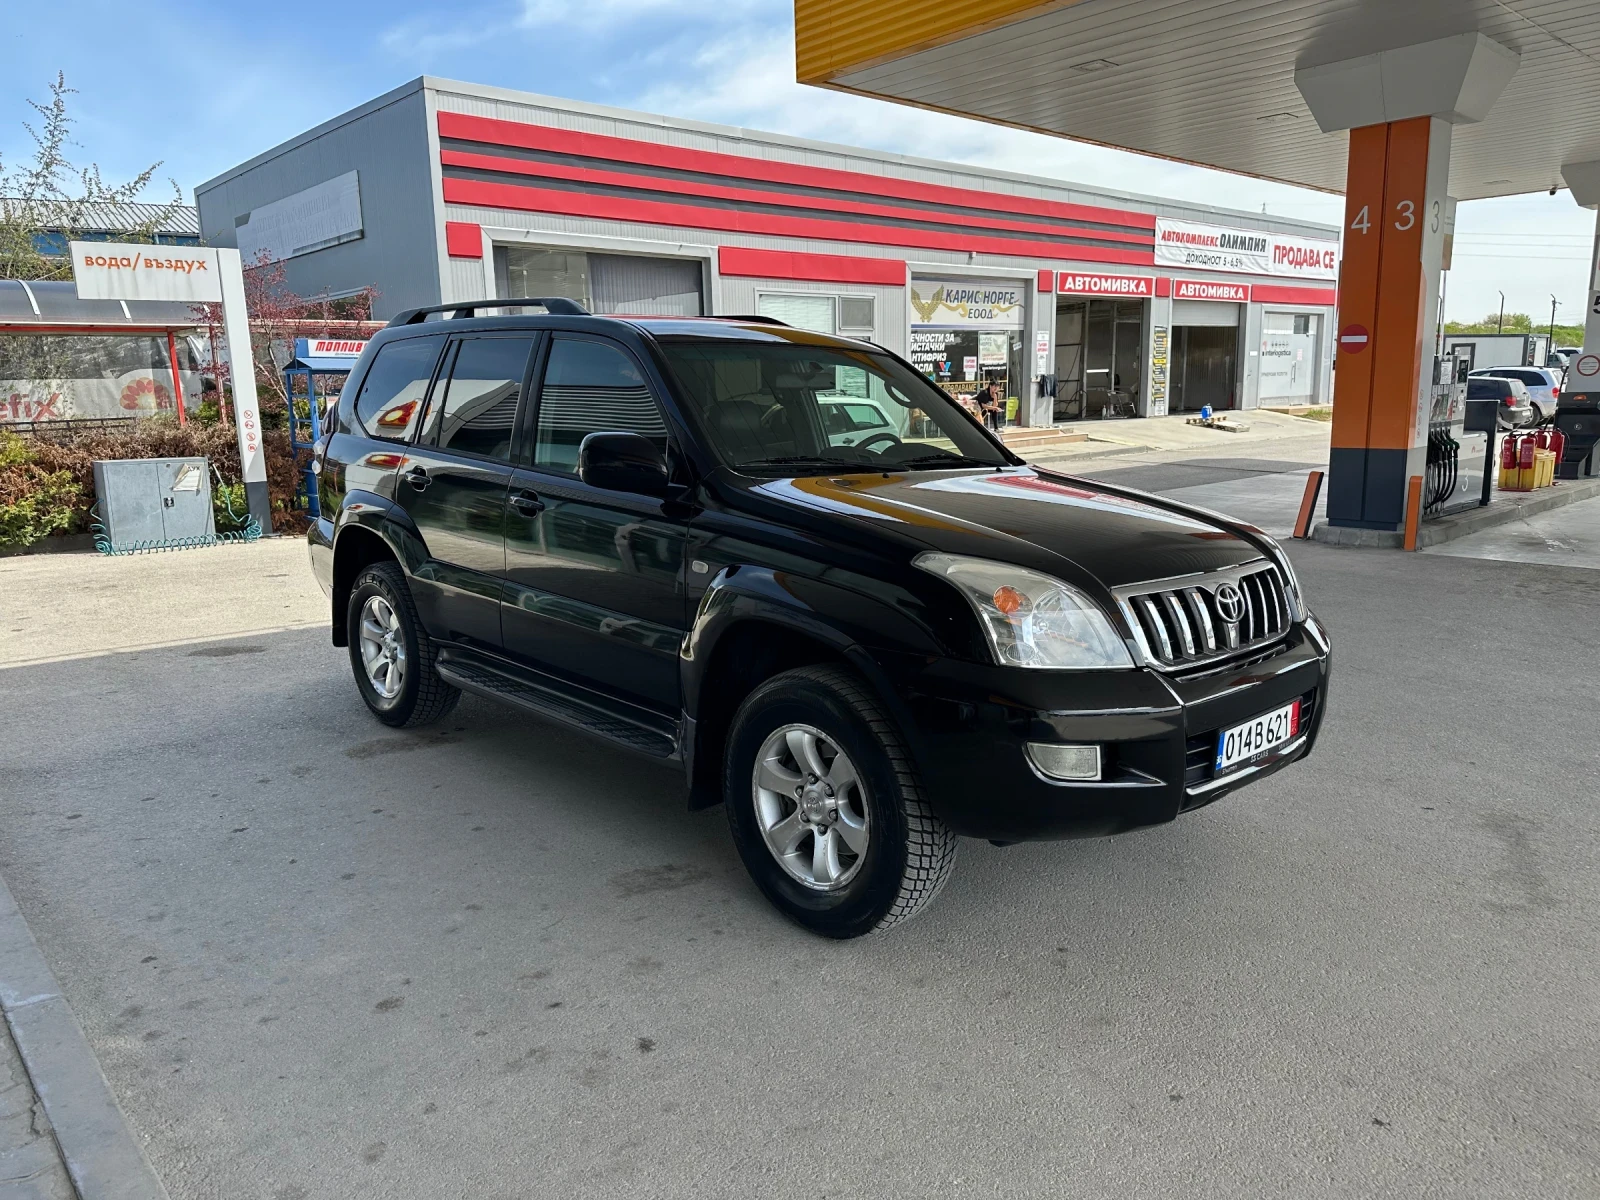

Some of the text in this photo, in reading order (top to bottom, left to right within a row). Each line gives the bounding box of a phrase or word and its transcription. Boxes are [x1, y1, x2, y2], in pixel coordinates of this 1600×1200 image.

[1351, 205, 1371, 235] 4
[1394, 200, 1415, 231] 3
[1431, 200, 1440, 234] 3
[1161, 230, 1267, 253] АВТОКОМПЛЕКС ОЛИМПИЯ
[1185, 252, 1222, 266] ДОХОДНОСТ
[1273, 244, 1335, 270] ПРОДАВА СЕ
[144, 258, 208, 275] въздух
[1064, 276, 1147, 293] АВТОМИВКА
[1179, 283, 1244, 299] АВТОМИВКА
[945, 288, 1016, 305] КАРИС НОРГЕ
[967, 308, 994, 319] ЕООД
[910, 333, 955, 343] ЕЧНОСТИ ЗА
[911, 342, 946, 352] ИСТАЧКИ
[911, 352, 947, 362] НТИФРИЗ
[912, 362, 934, 372] АСЛА
